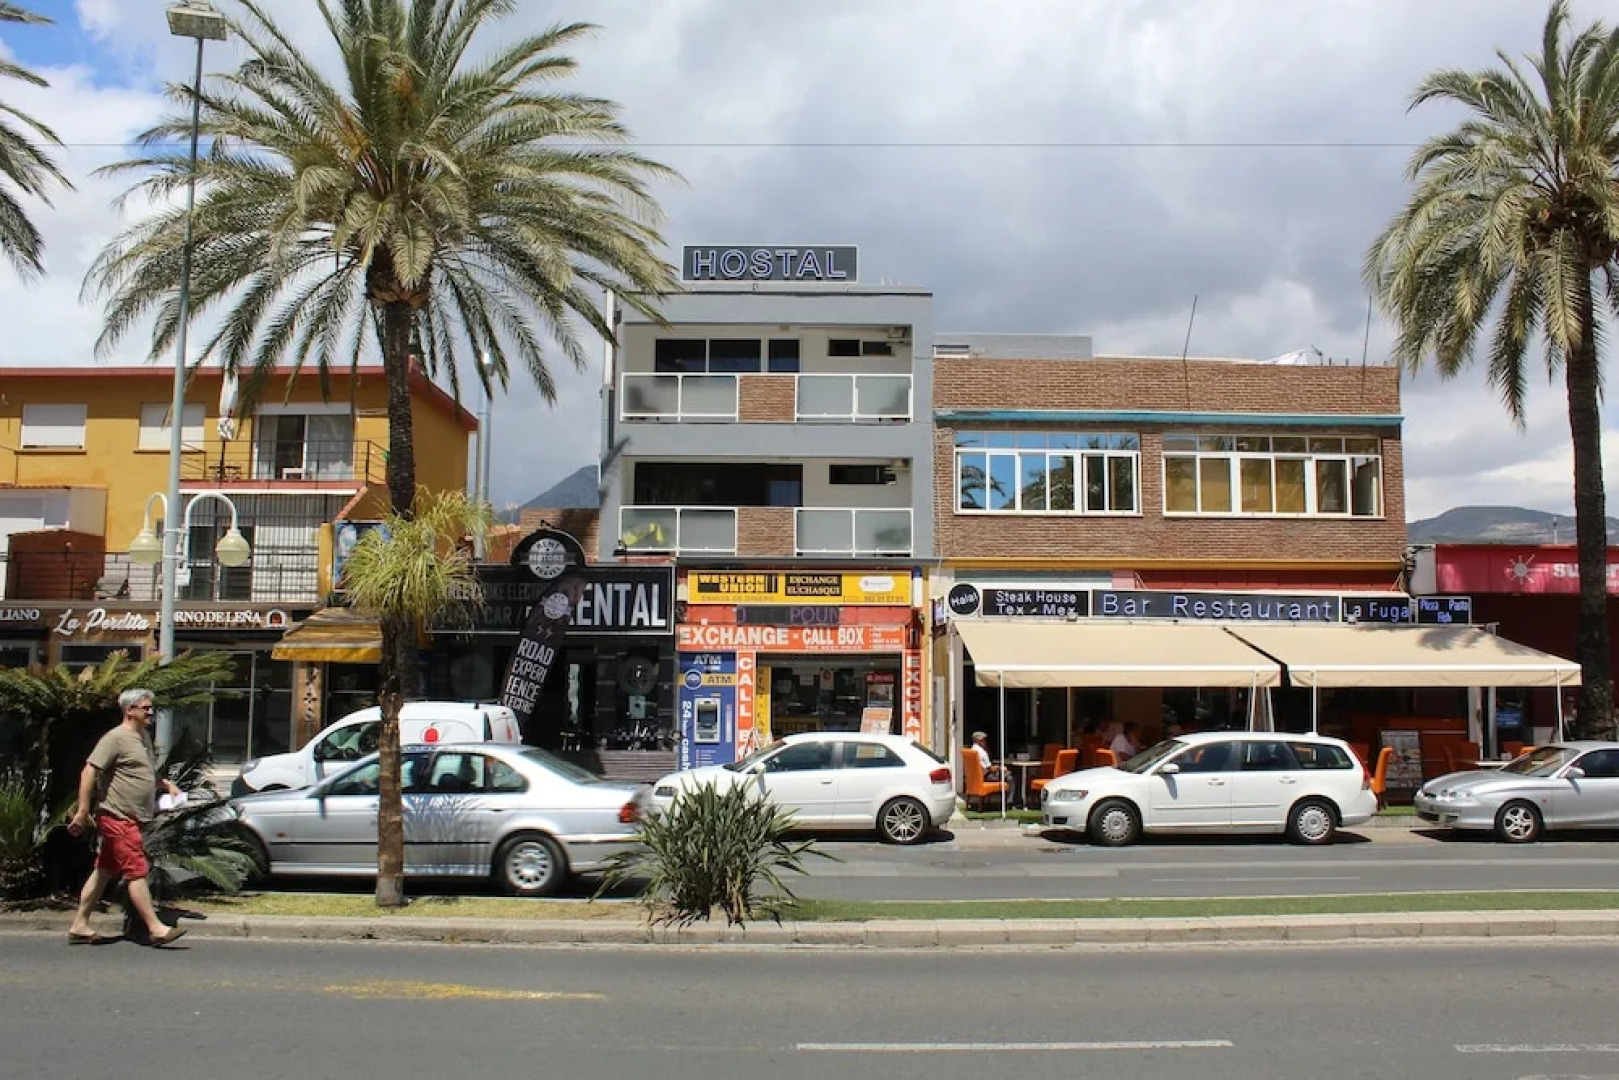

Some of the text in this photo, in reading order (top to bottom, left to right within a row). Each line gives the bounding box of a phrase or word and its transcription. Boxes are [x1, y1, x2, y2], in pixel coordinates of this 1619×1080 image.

[693, 249, 847, 278] HOSTAL
[699, 574, 764, 584] WESTERN
[720, 583, 764, 592] UNION
[790, 576, 838, 584] EXCHANGE
[568, 582, 667, 626] ENTAL
[951, 592, 978, 606] Halal
[996, 590, 1076, 604] Steak House
[996, 603, 1024, 615] Tex
[1043, 604, 1076, 615] Mex
[1103, 594, 1332, 619] Bar Restaurant
[1343, 602, 1410, 622] La Fuga
[53, 608, 151, 635] La Perdita
[680, 627, 789, 645] EXCHANGE
[803, 628, 834, 645] CALL
[838, 627, 864, 645] BOX
[517, 638, 555, 665] ROAD
[693, 654, 722, 665] ATM
[707, 675, 731, 684] ATM
[739, 657, 752, 717] CALL
[682, 701, 693, 718] 24
